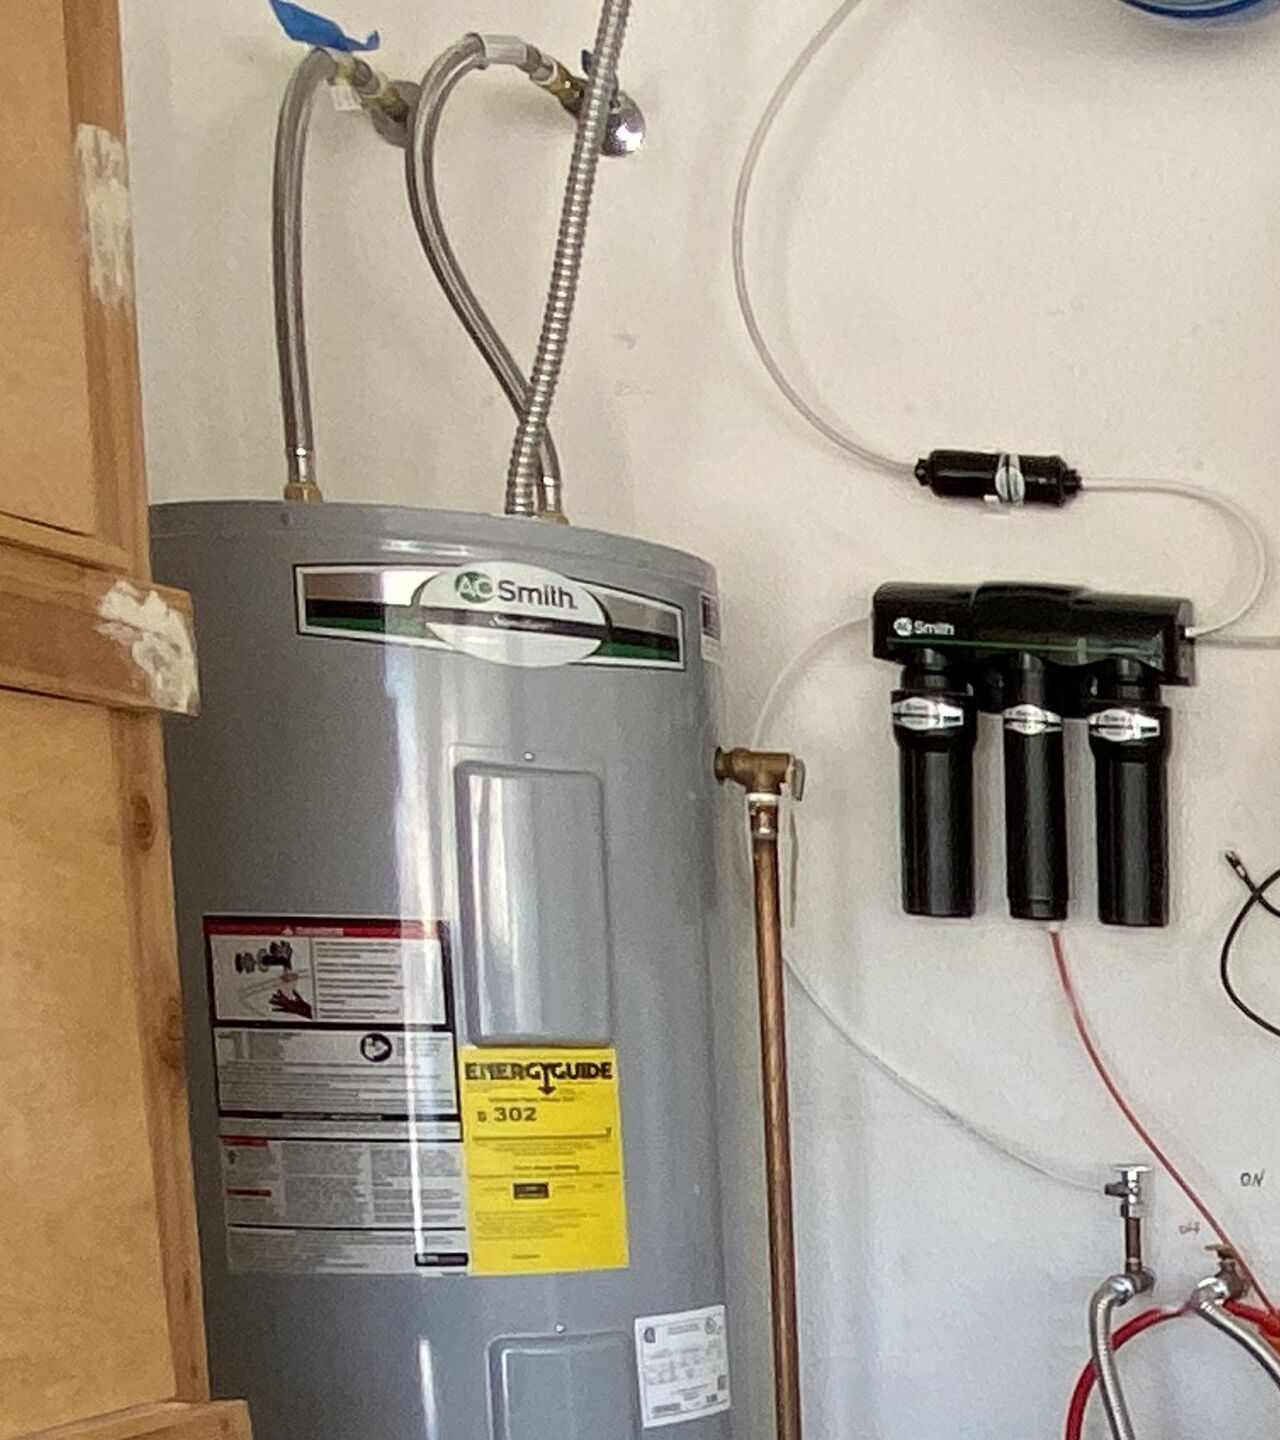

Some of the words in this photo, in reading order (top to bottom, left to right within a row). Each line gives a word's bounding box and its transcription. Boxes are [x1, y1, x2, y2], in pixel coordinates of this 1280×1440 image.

[497, 580, 577, 609] Smith
[494, 1107, 537, 1122] 302
[1240, 1168, 1265, 1187] ON
